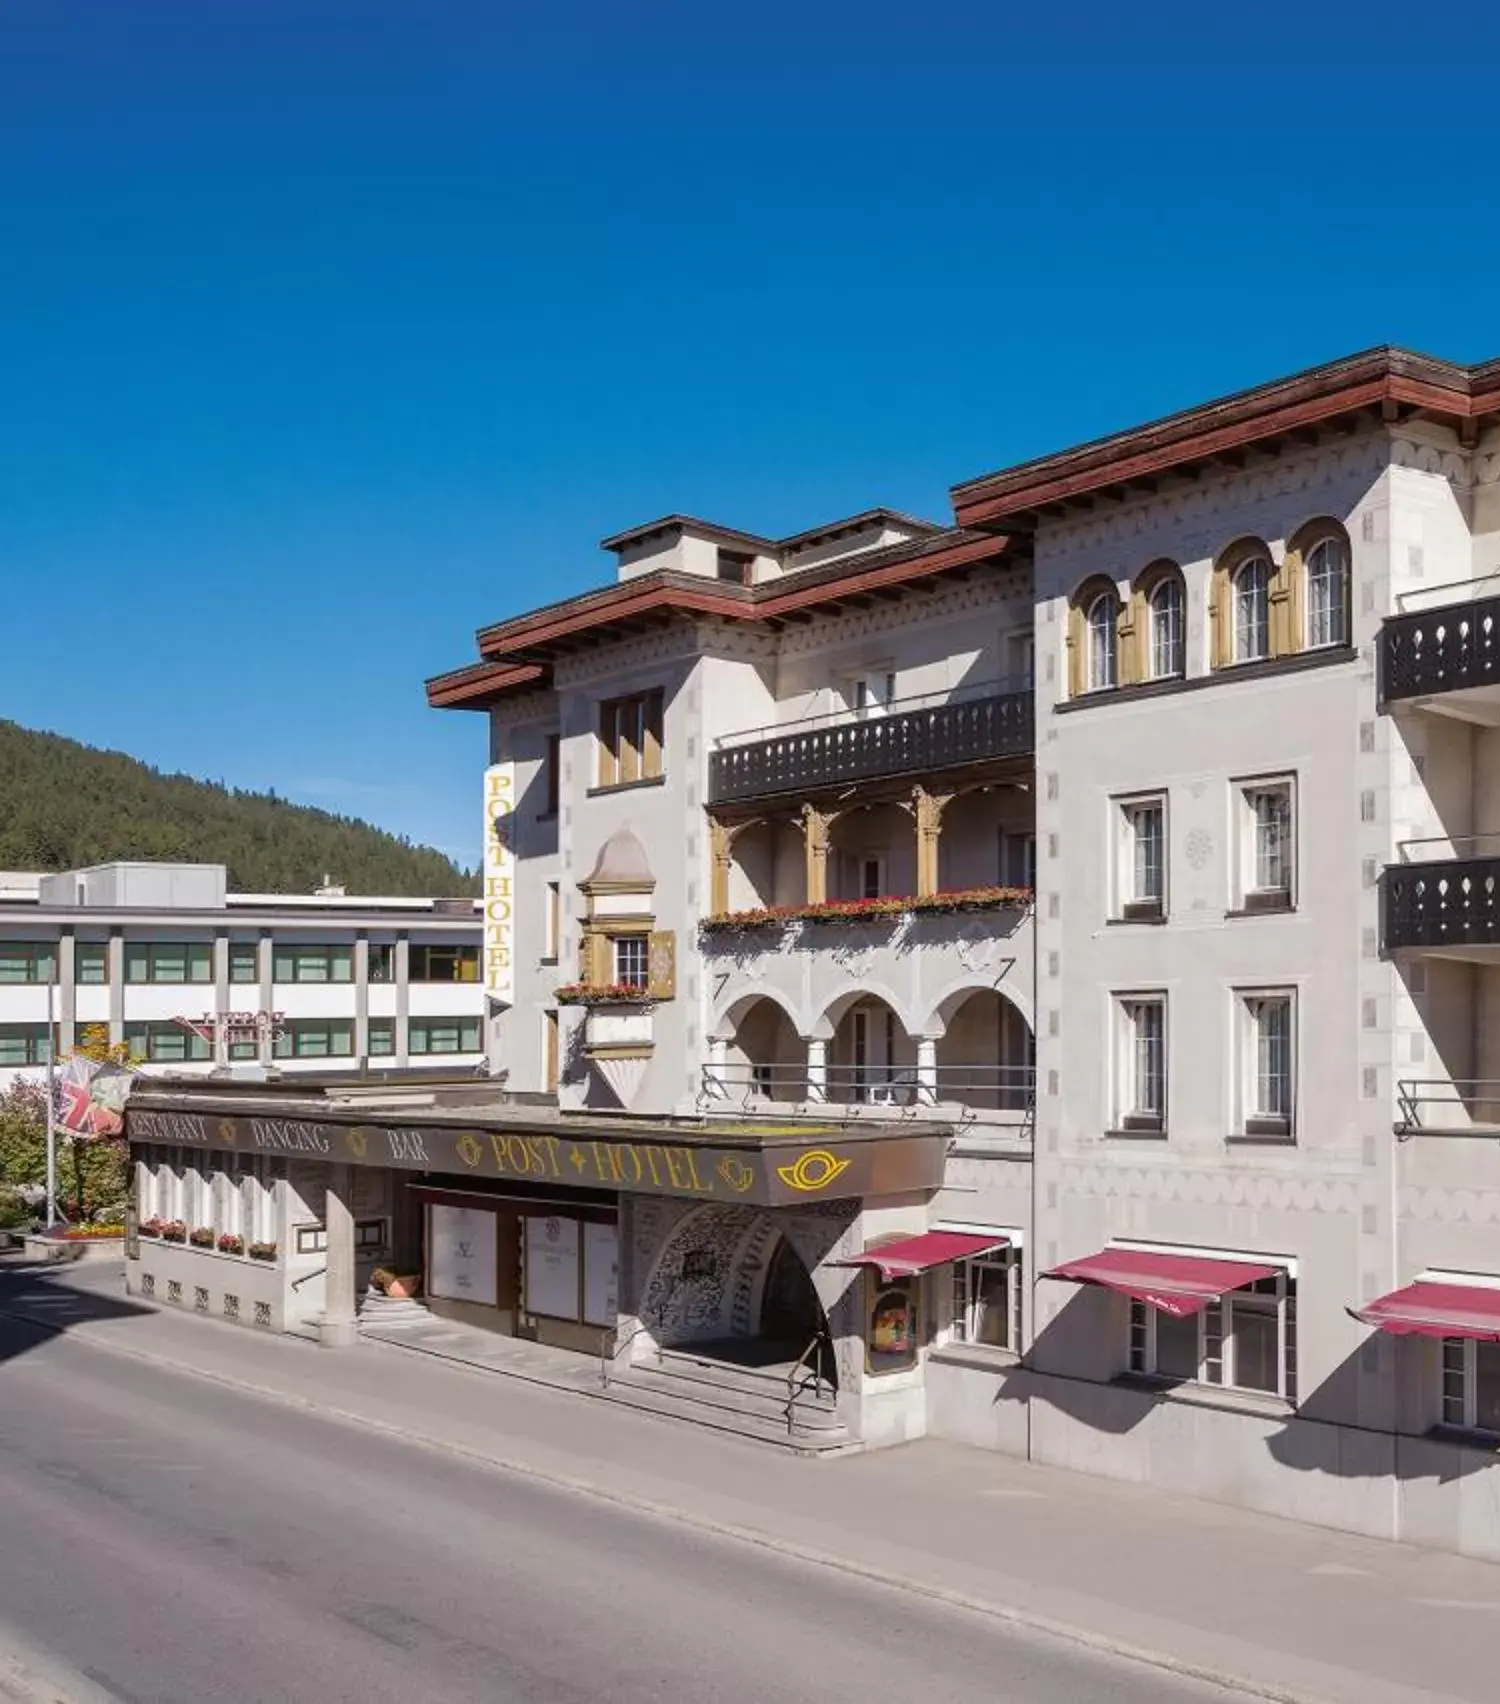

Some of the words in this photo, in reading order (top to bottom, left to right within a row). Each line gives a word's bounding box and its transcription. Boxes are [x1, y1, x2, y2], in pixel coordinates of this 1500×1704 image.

[486, 877, 512, 990] HOTEL
[252, 1119, 330, 1153] DANCING
[387, 1130, 428, 1162] BAR
[491, 1135, 560, 1177] POST
[591, 1141, 713, 1192] HOTEL
